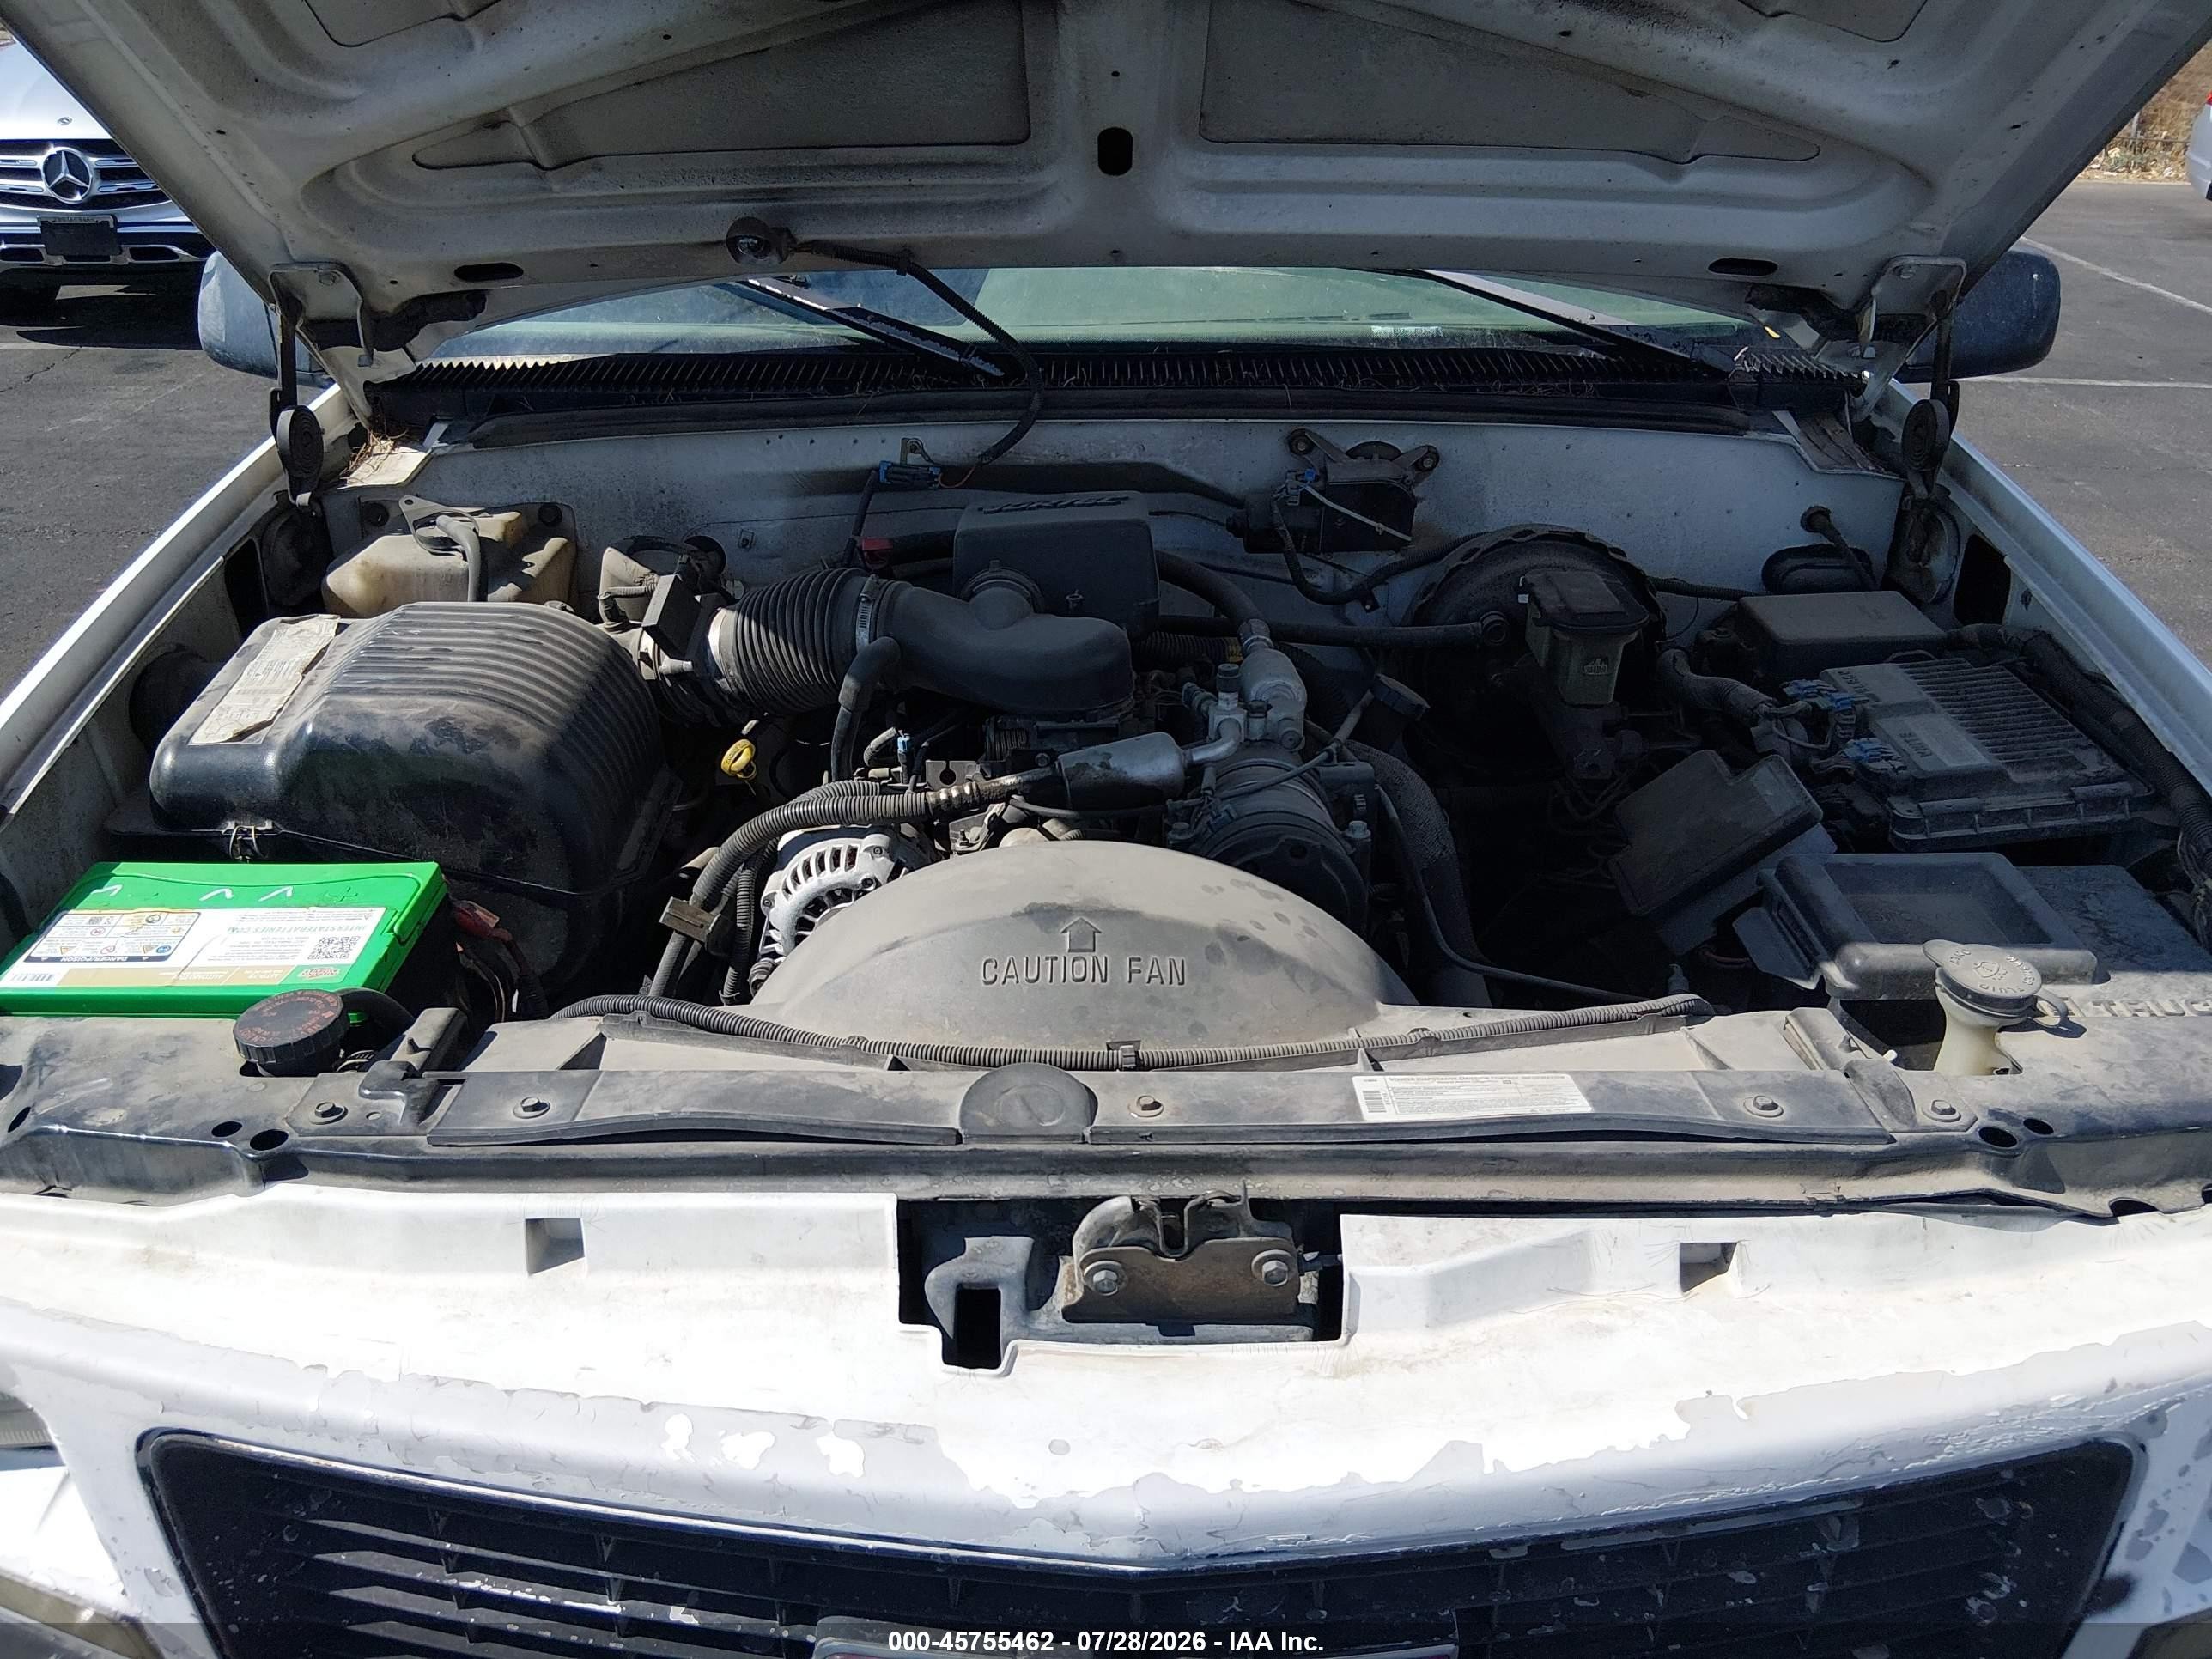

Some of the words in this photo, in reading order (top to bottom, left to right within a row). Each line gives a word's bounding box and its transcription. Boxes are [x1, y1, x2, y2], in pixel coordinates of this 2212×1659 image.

[981, 955, 1109, 986] CAUTION
[1127, 957, 1186, 987] FAN
[2006, 954, 2036, 987] WASHER
